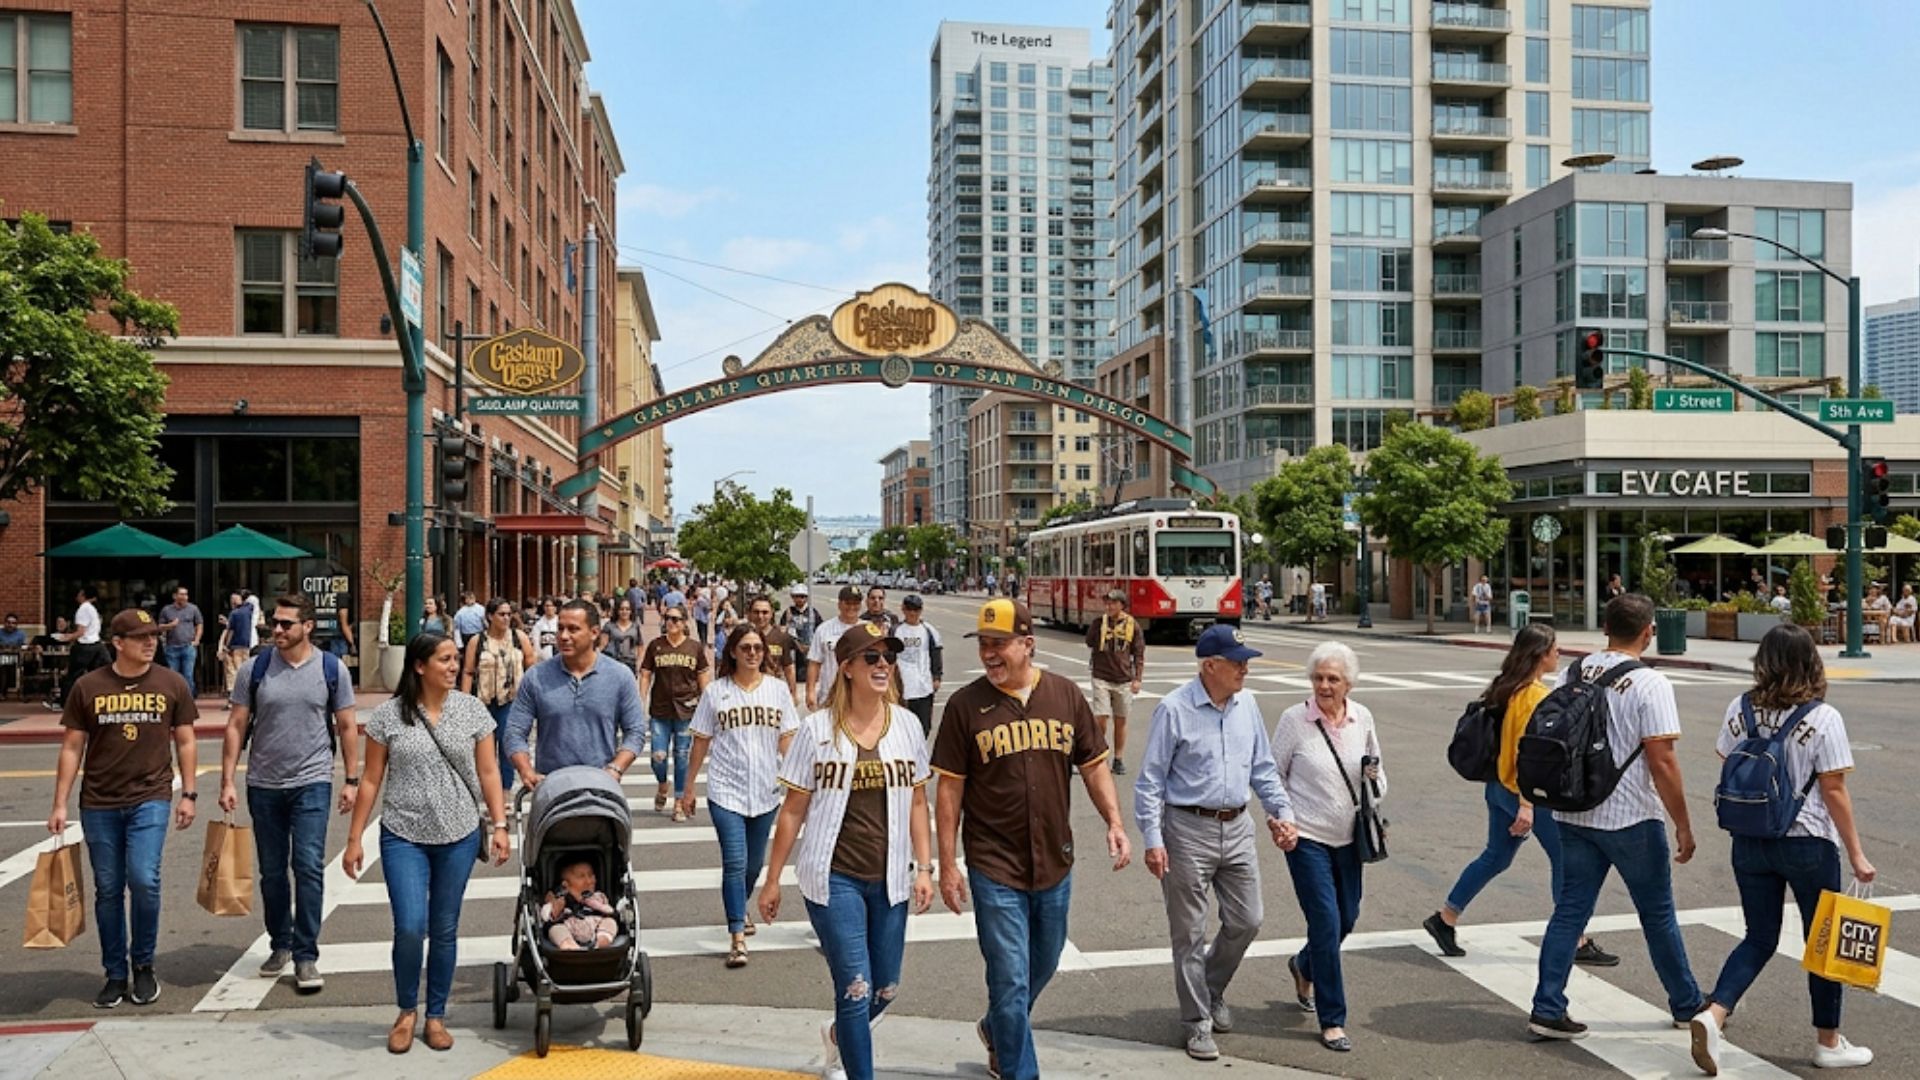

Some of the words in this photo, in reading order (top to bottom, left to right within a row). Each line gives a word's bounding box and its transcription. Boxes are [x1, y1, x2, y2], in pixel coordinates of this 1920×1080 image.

[971, 31, 998, 45] The
[1001, 32, 1052, 50] Legend
[633, 381, 741, 425] GASLAMP
[756, 362, 863, 387] QUARTER
[975, 368, 1018, 386] SAN
[1082, 393, 1147, 427] DIEGO
[1665, 394, 1673, 408] J
[1679, 393, 1723, 408] Street
[1856, 404, 1884, 419] Ave
[1621, 470, 1660, 496] EV
[1670, 469, 1751, 496] CAFE
[303, 576, 332, 593] CITY
[975, 718, 1075, 764] PADRES
[1841, 920, 1879, 942] CITY
[1840, 938, 1876, 963] LIFE
